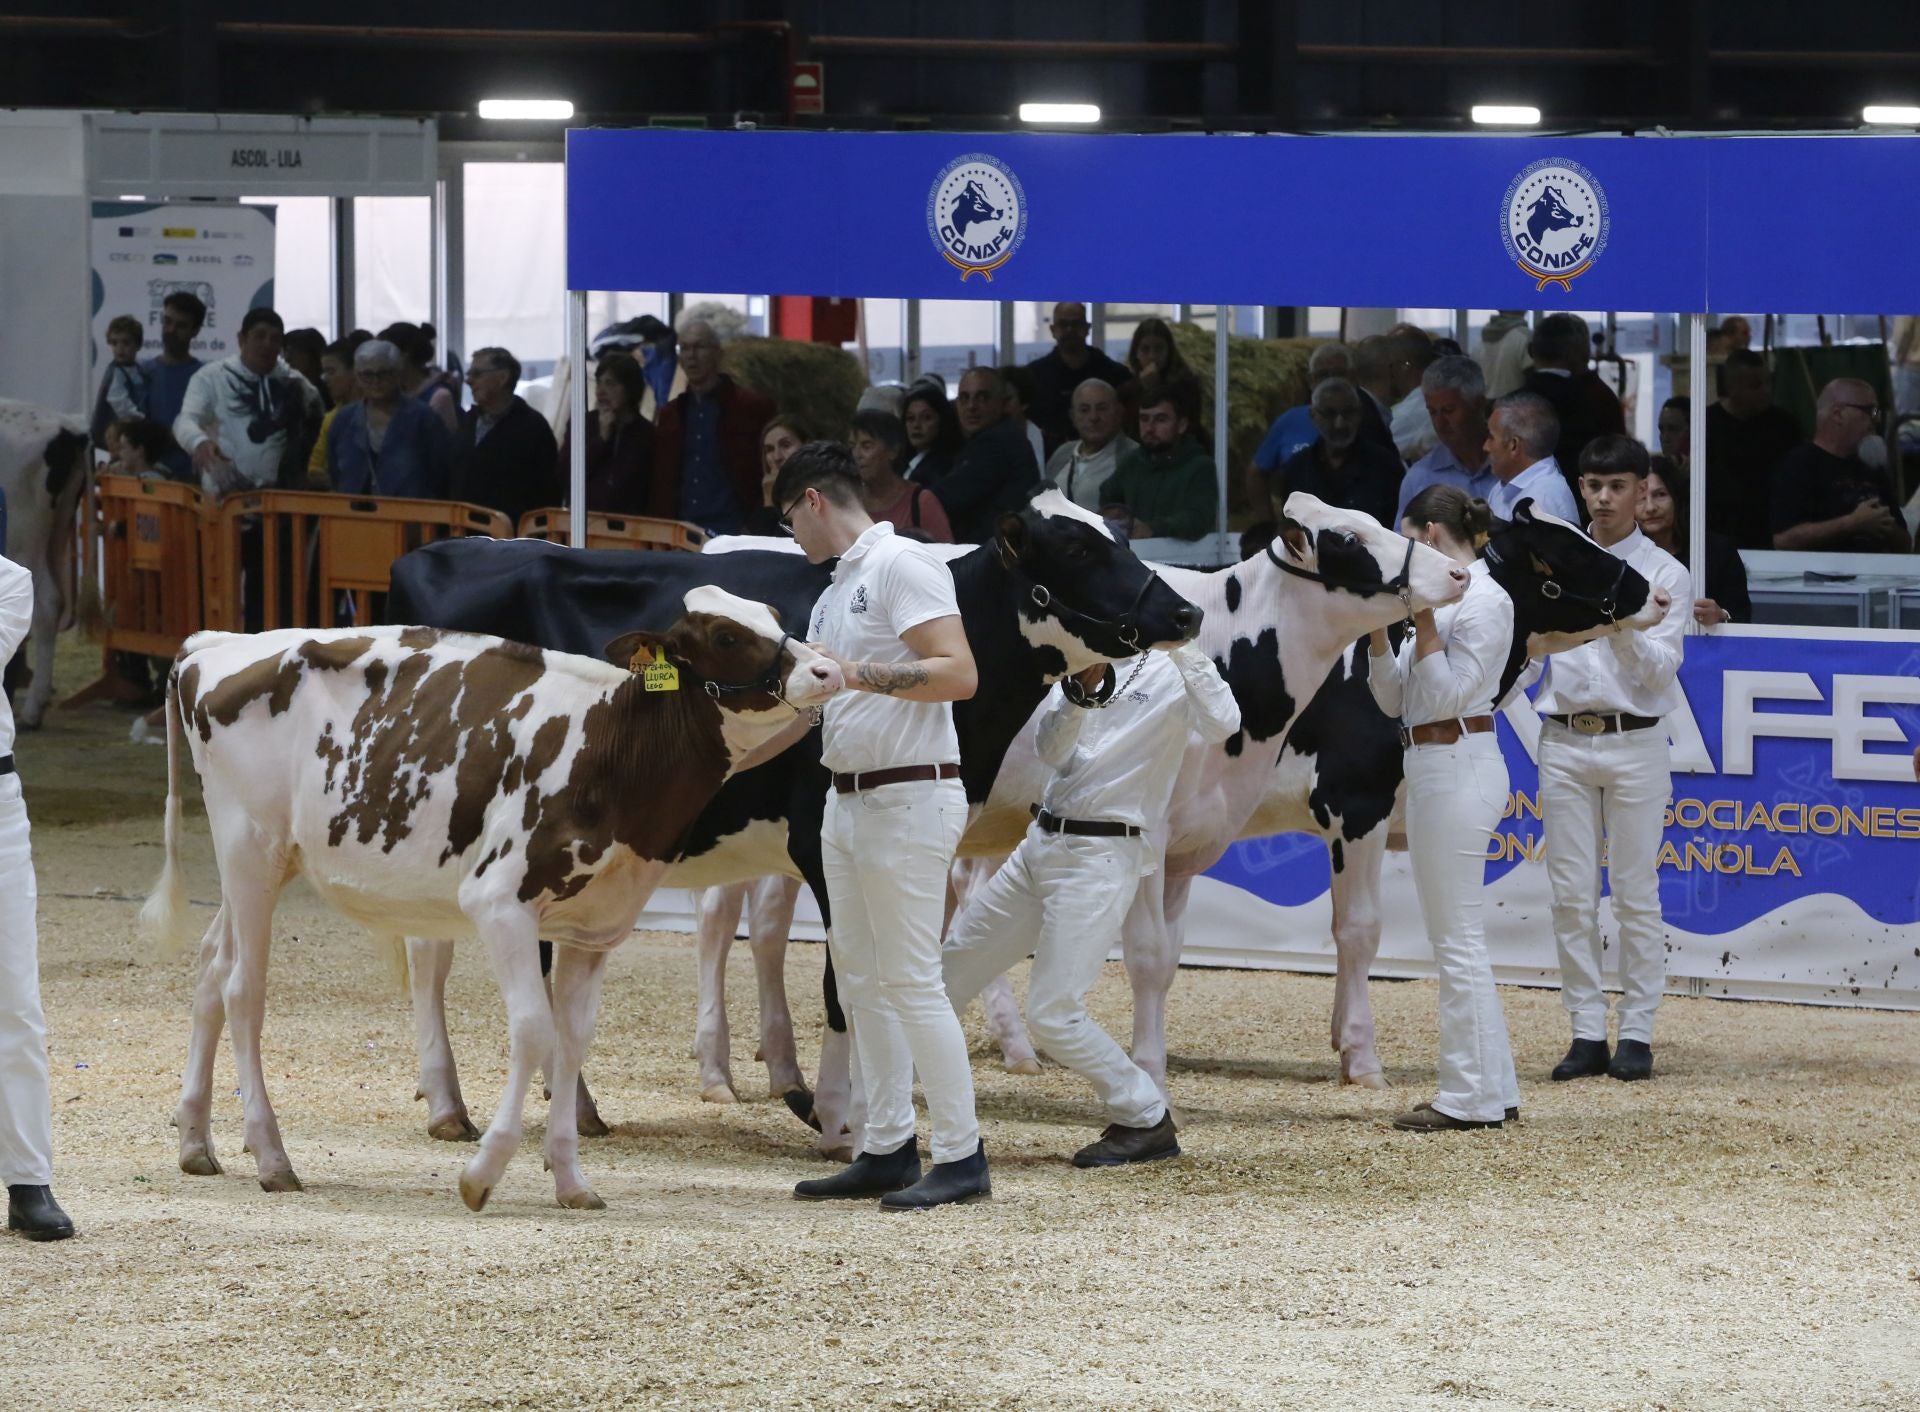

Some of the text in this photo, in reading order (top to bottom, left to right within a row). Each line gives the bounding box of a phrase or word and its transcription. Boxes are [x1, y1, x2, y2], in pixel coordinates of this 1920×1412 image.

[232, 149, 269, 167] ASCOL
[278, 149, 302, 167] LILA
[941, 225, 1013, 259] CONAFE
[1515, 232, 1594, 268] CONAFE
[210, 337, 226, 350] de
[646, 671, 675, 682] LLURCA
[1656, 836, 1802, 877] AÑOLA
